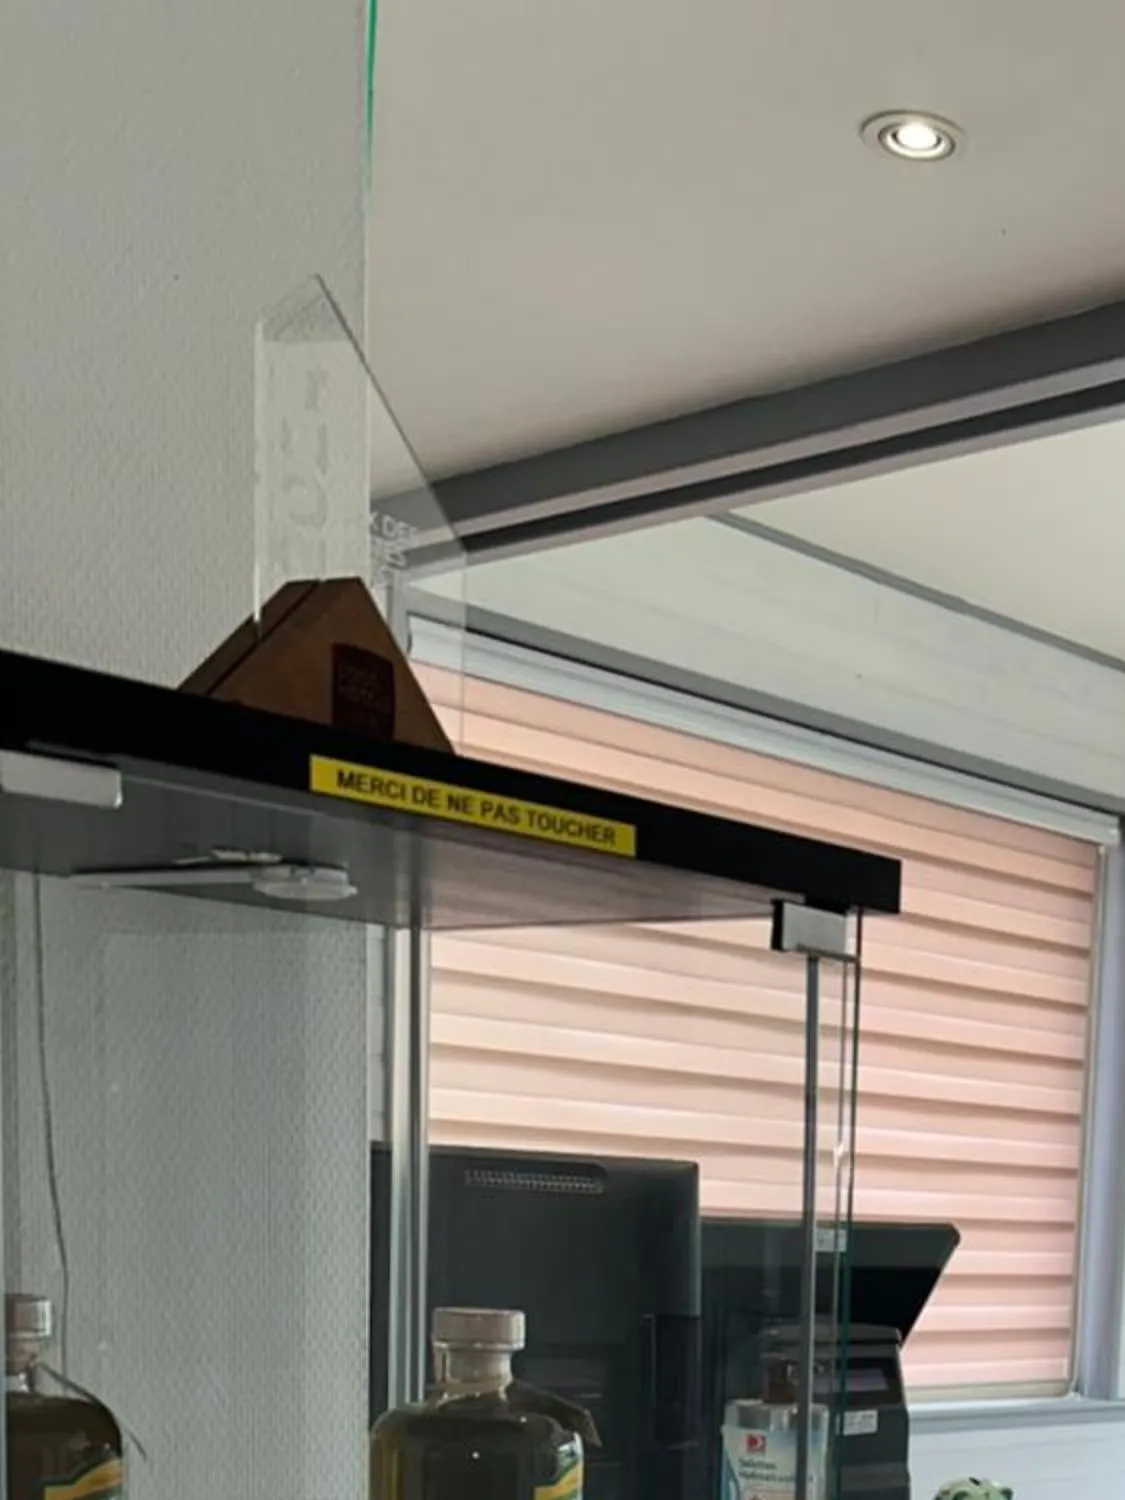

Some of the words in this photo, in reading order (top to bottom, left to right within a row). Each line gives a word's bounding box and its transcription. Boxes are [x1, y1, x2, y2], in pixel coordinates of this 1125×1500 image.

[336, 768, 405, 799] MERCI
[412, 785, 441, 808] DE
[447, 794, 475, 816] NE
[480, 800, 521, 826] PAS
[527, 810, 617, 845] TOUCHER
